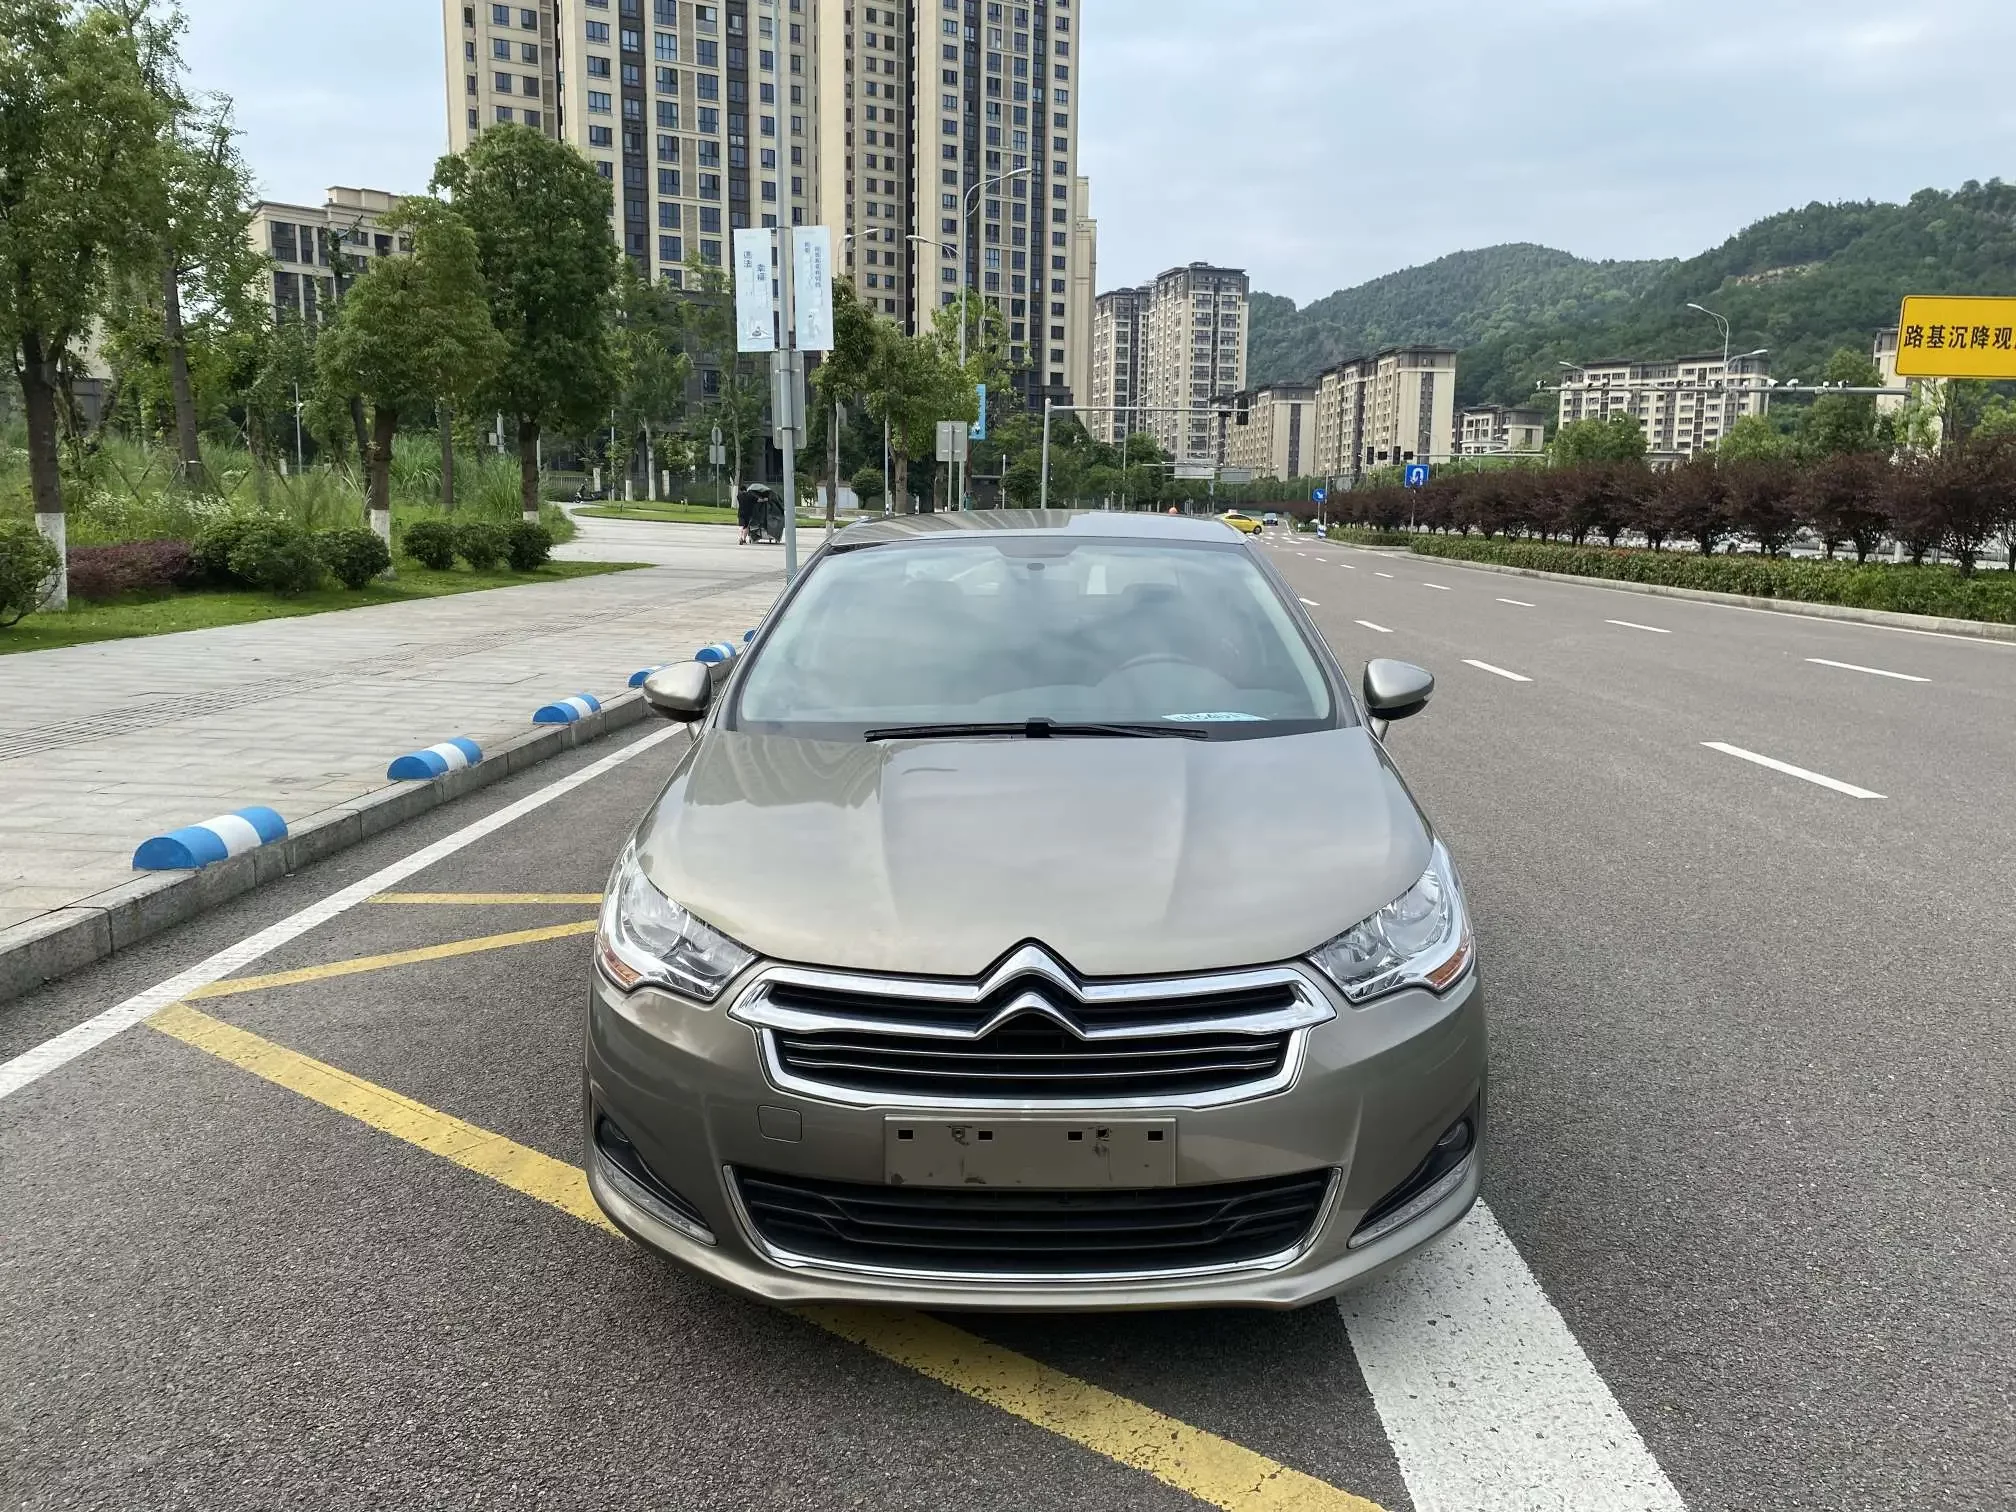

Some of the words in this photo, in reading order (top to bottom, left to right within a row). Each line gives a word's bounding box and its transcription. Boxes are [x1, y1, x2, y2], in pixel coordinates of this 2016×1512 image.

[1903, 324, 2016, 350] 路基沉降观
